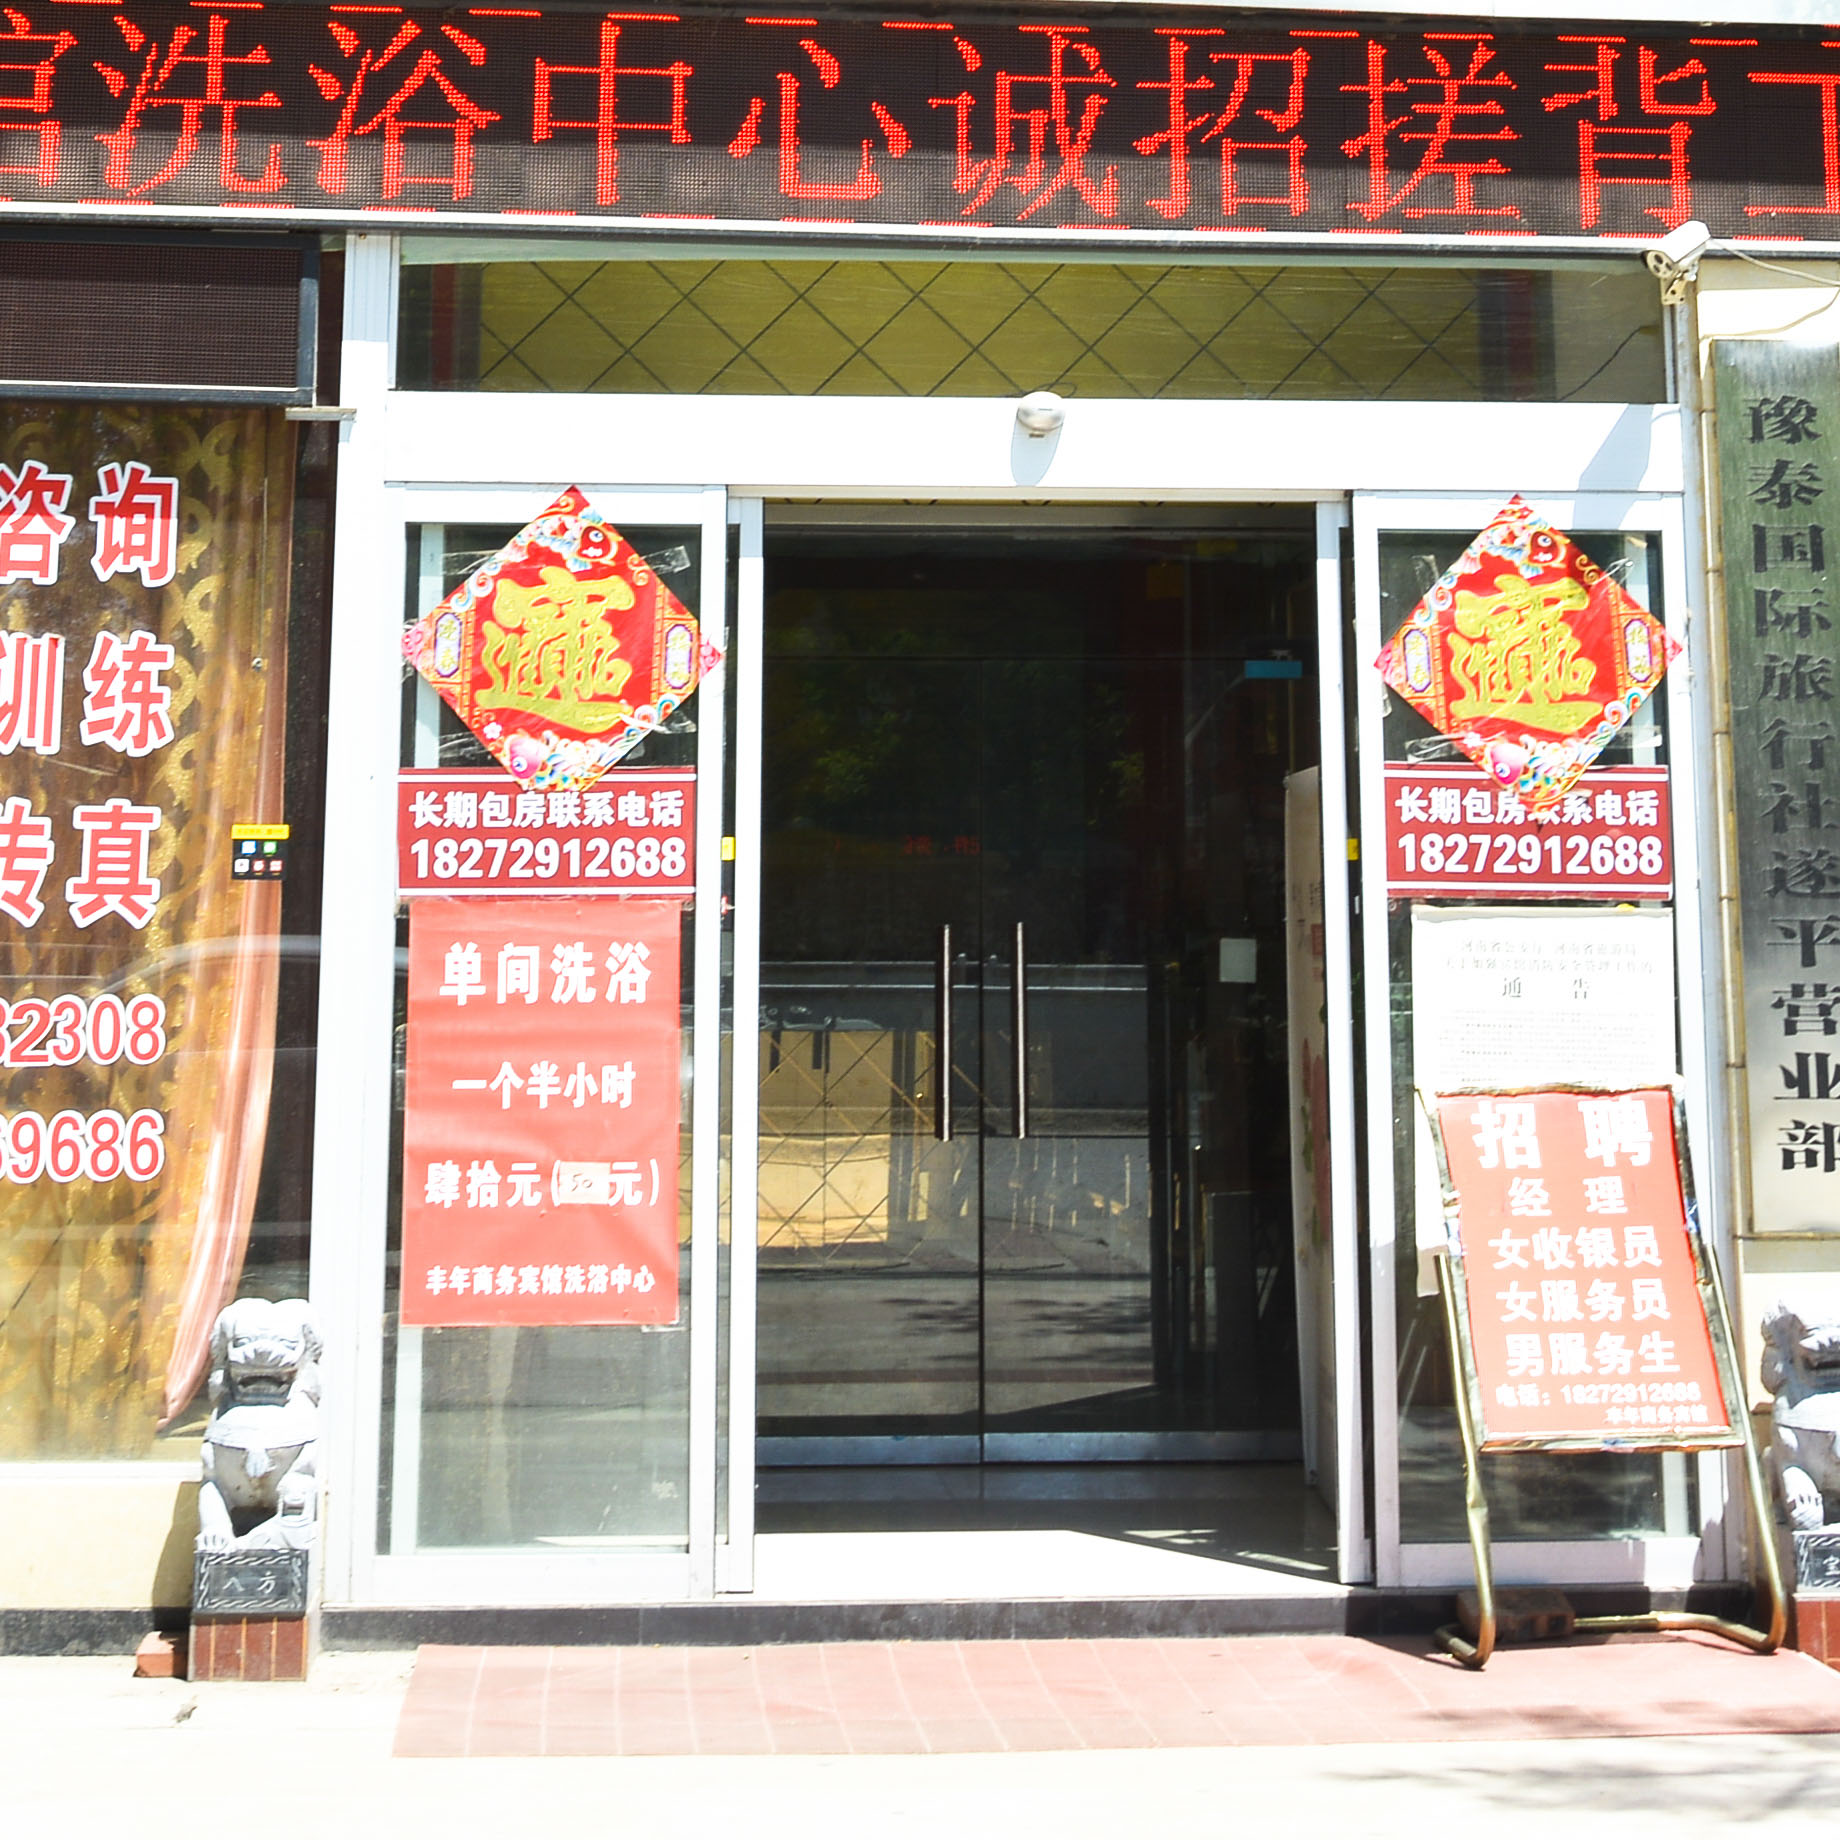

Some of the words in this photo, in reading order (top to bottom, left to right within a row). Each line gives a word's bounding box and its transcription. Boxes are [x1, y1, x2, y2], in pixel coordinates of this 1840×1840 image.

[409, 790, 684, 828] 长期包房联系电话
[411, 837, 686, 878] 18272912688
[1398, 833, 1663, 875] 18272912688
[439, 942, 652, 1005] 单间洗浴
[451, 1061, 636, 1109] 一个半小时
[1471, 1099, 1653, 1169] 招聘
[1507, 1176, 1627, 1218] 经理
[1489, 1225, 1662, 1271] 女收银员
[426, 1265, 655, 1295] 丰年商务宾馆洗浴中心
[1496, 1278, 1670, 1324] 女服务员
[1506, 1330, 1681, 1378] 男服务生
